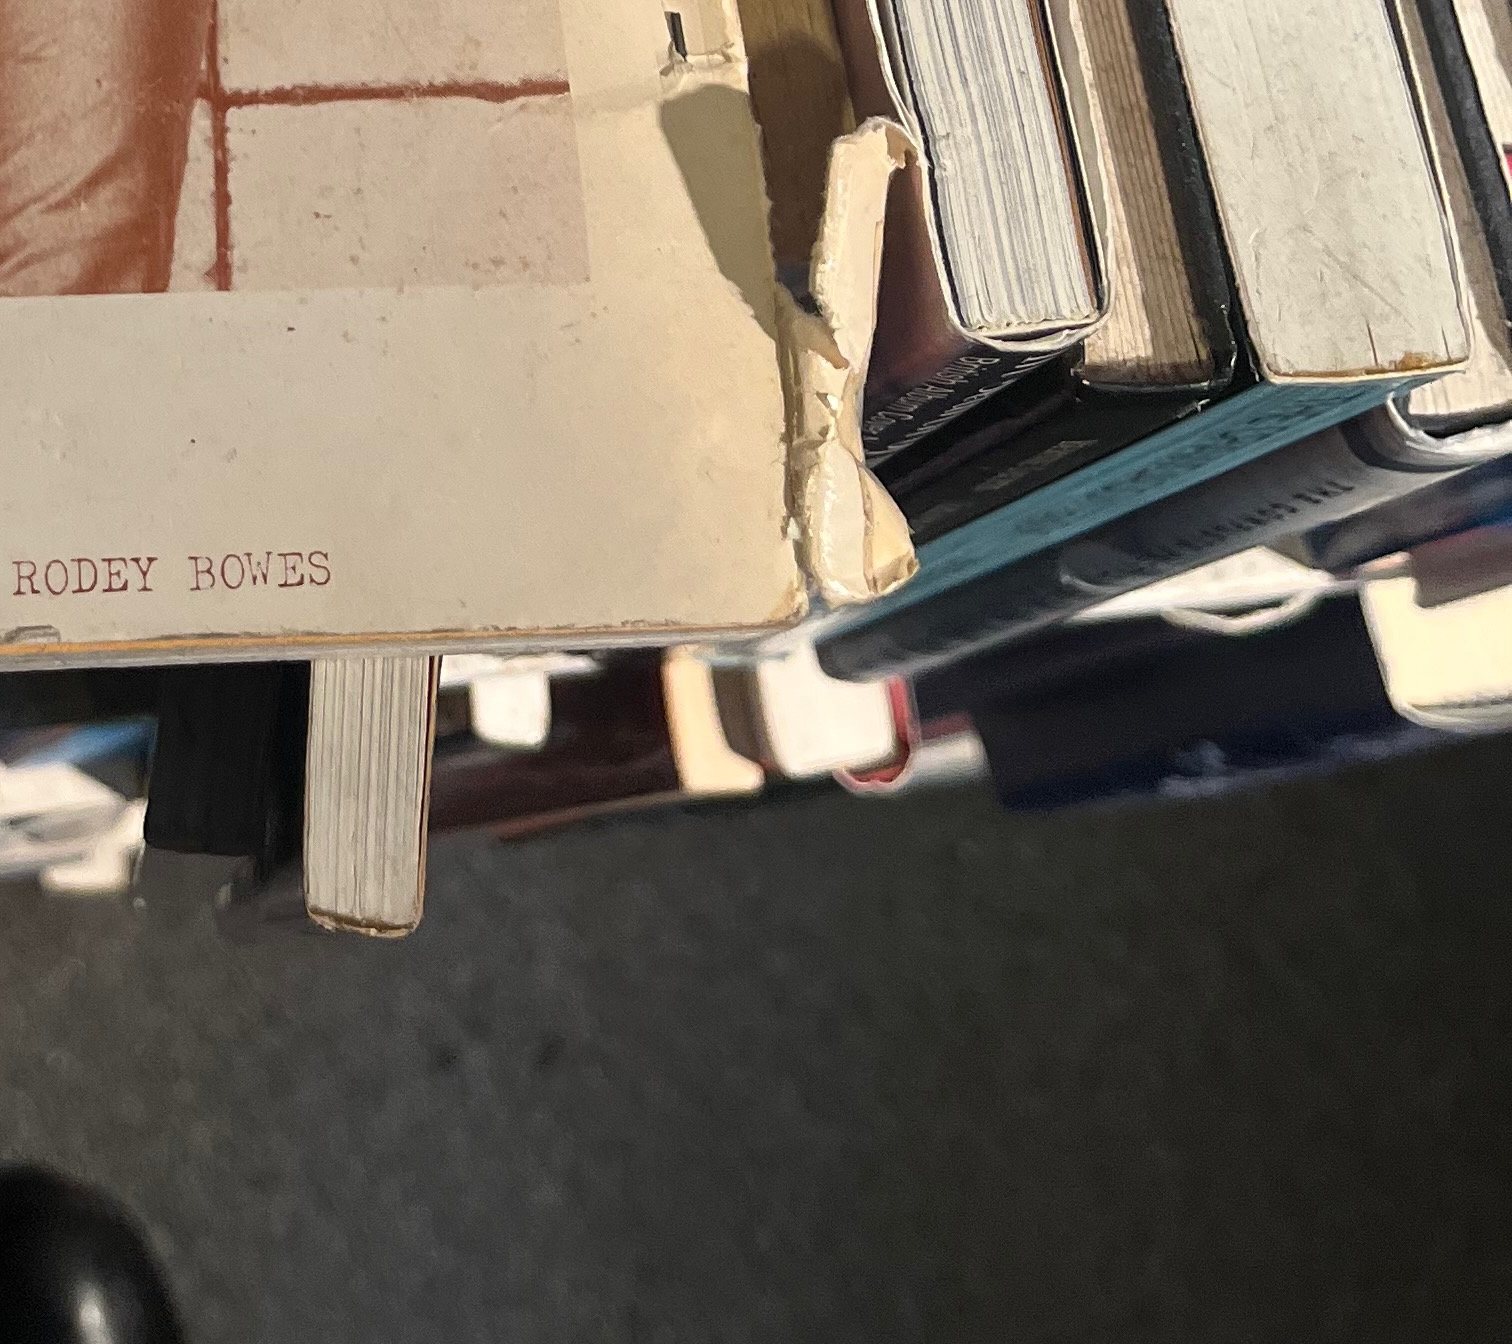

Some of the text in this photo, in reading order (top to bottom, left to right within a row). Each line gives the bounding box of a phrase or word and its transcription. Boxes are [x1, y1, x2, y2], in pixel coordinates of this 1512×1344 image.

[927, 356, 1002, 387] British
[11, 555, 160, 597] RODEY
[189, 550, 334, 594] BOWES
